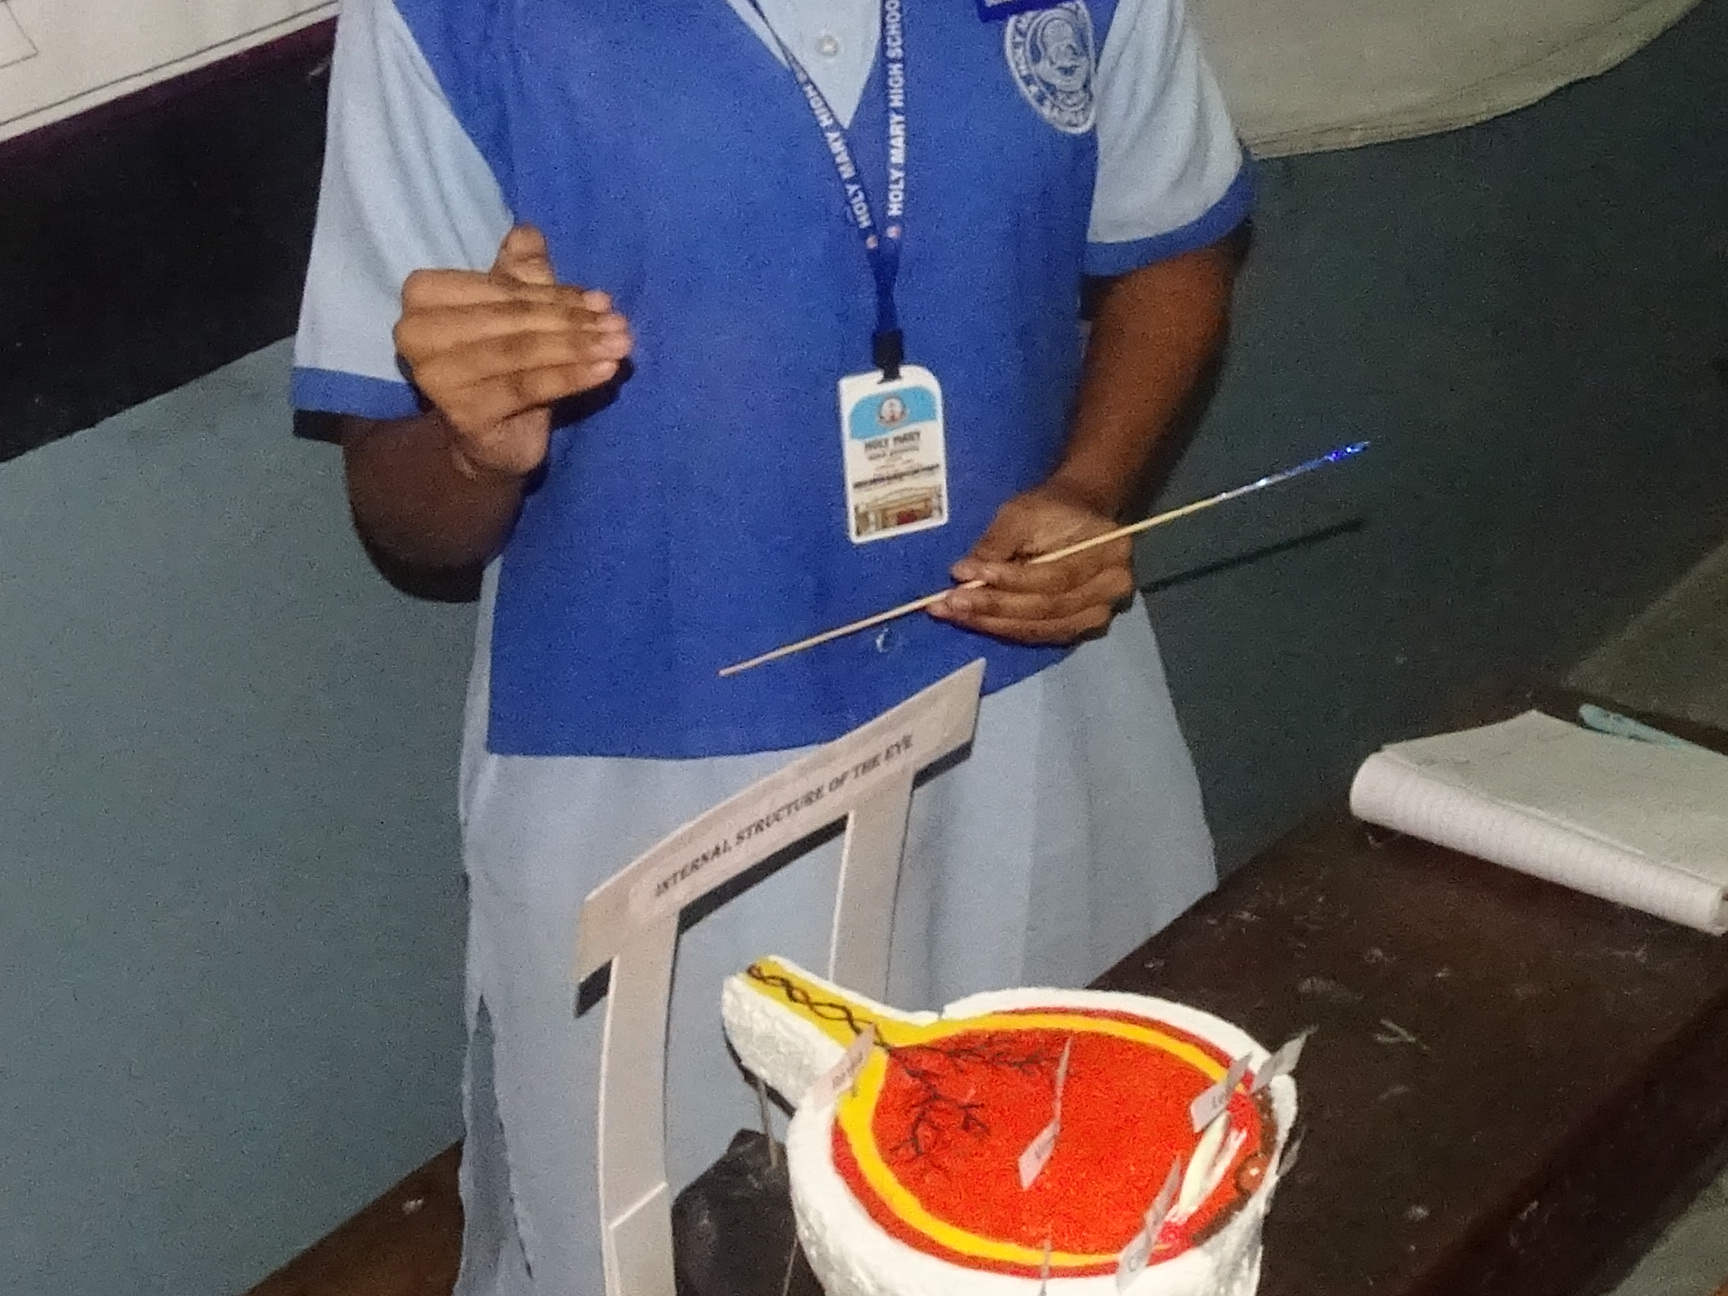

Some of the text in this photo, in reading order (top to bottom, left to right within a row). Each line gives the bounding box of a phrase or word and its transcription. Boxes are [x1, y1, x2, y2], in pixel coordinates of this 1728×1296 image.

[887, 62, 904, 108] HIGH
[802, 82, 872, 229] HOLY MARY HIGH
[889, 113, 905, 164] MARY
[887, 168, 904, 217] HOLY
[655, 733, 914, 897] INTERNAL STRUCTURE OF THE EYE
